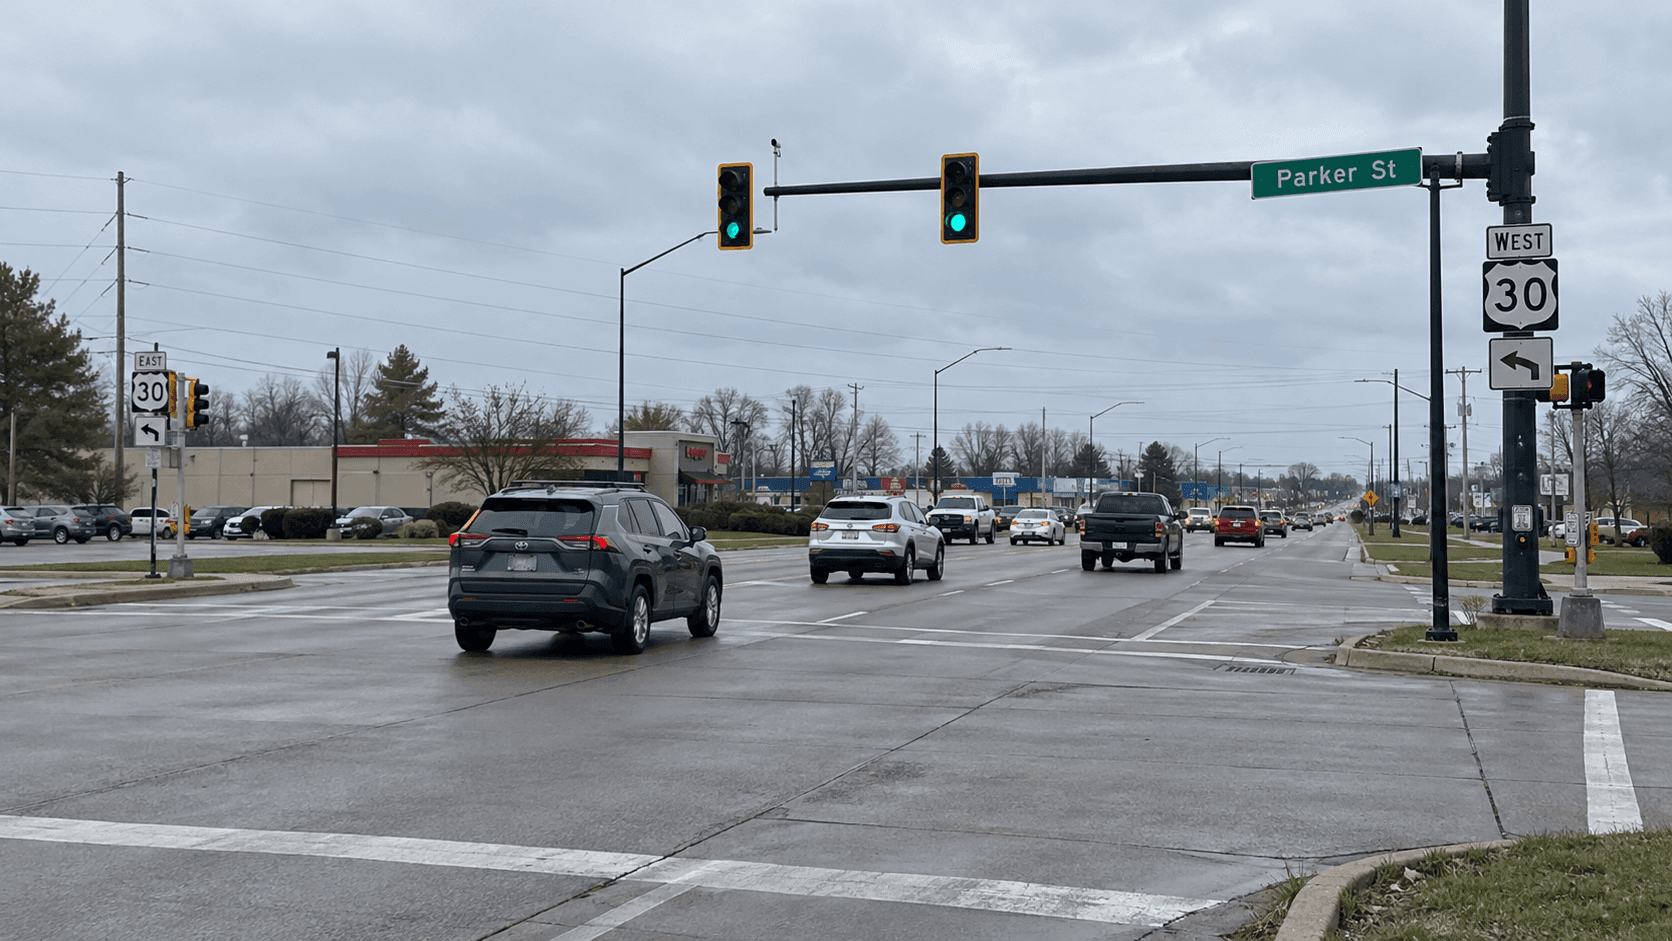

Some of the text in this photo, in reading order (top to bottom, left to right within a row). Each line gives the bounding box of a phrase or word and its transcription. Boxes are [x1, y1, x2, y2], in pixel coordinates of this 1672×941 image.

[1277, 159, 1397, 188] Parker St
[1495, 231, 1544, 252] WEST
[1494, 277, 1547, 312] 30
[139, 355, 162, 367] EAST
[137, 381, 164, 402] 30
